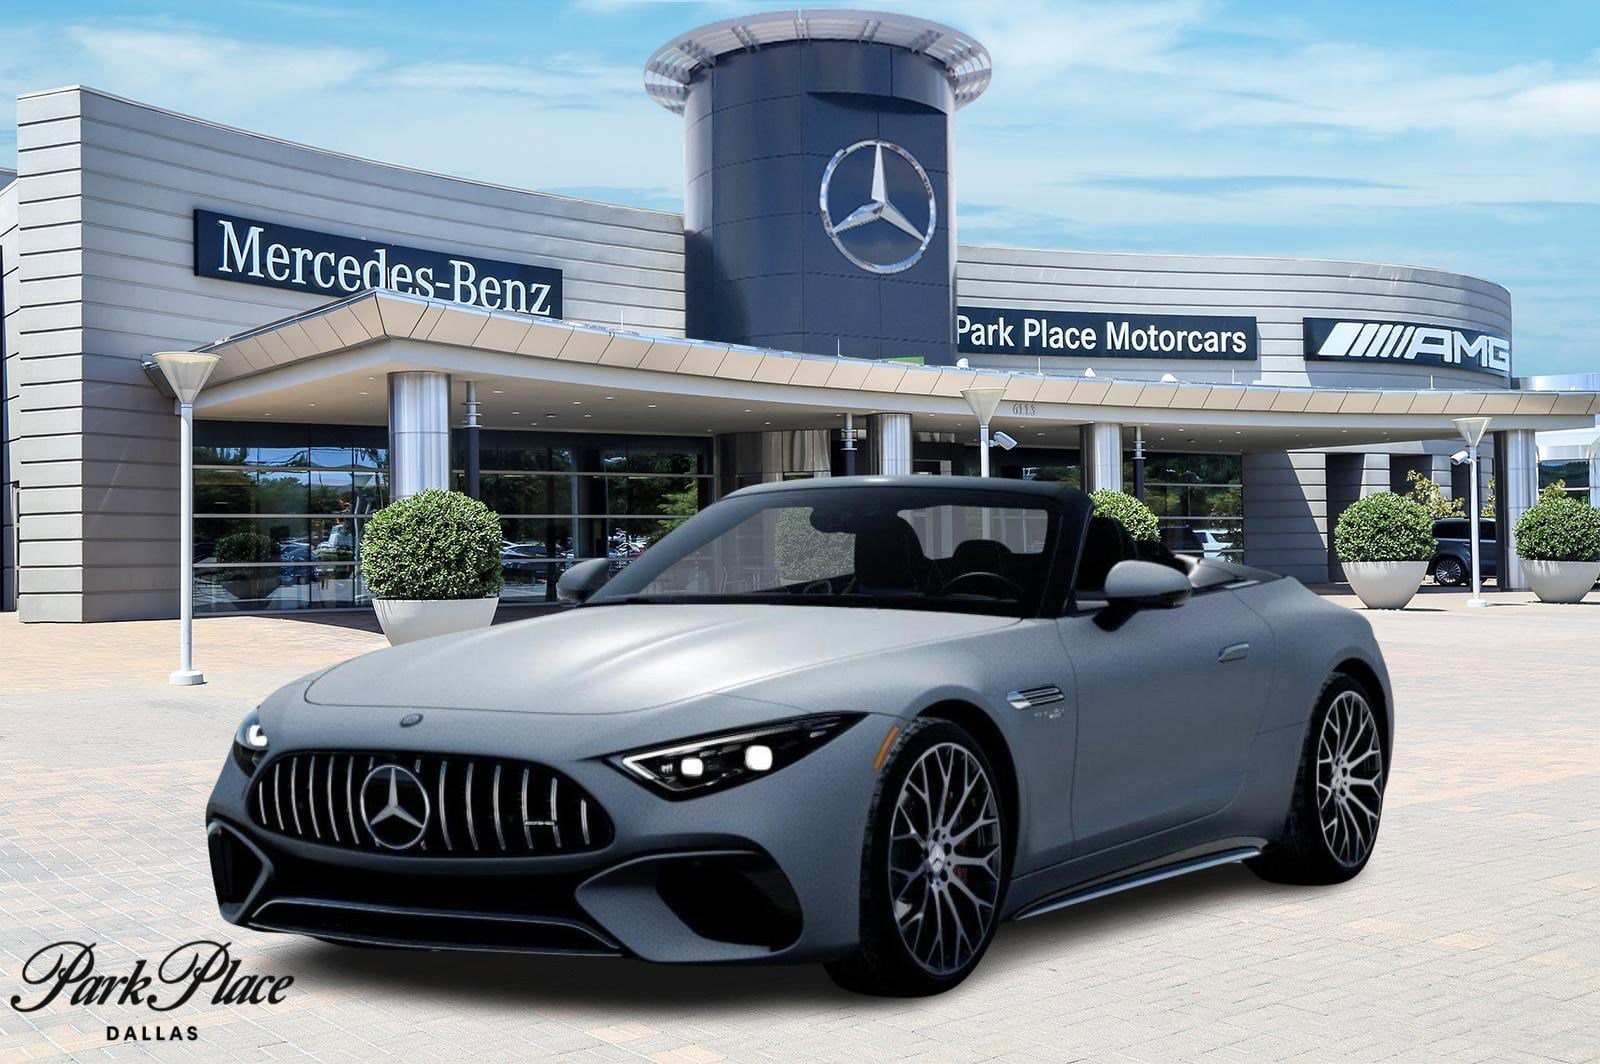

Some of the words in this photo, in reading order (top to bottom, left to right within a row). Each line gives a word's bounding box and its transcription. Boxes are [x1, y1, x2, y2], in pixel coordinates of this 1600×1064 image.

[217, 219, 552, 316] Mercedes-Benz
[957, 315, 1015, 348] Park
[1023, 316, 1097, 351] Place
[1106, 321, 1248, 355] Motorcars
[1405, 326, 1510, 371] AMG
[1012, 402, 1036, 417] 6113
